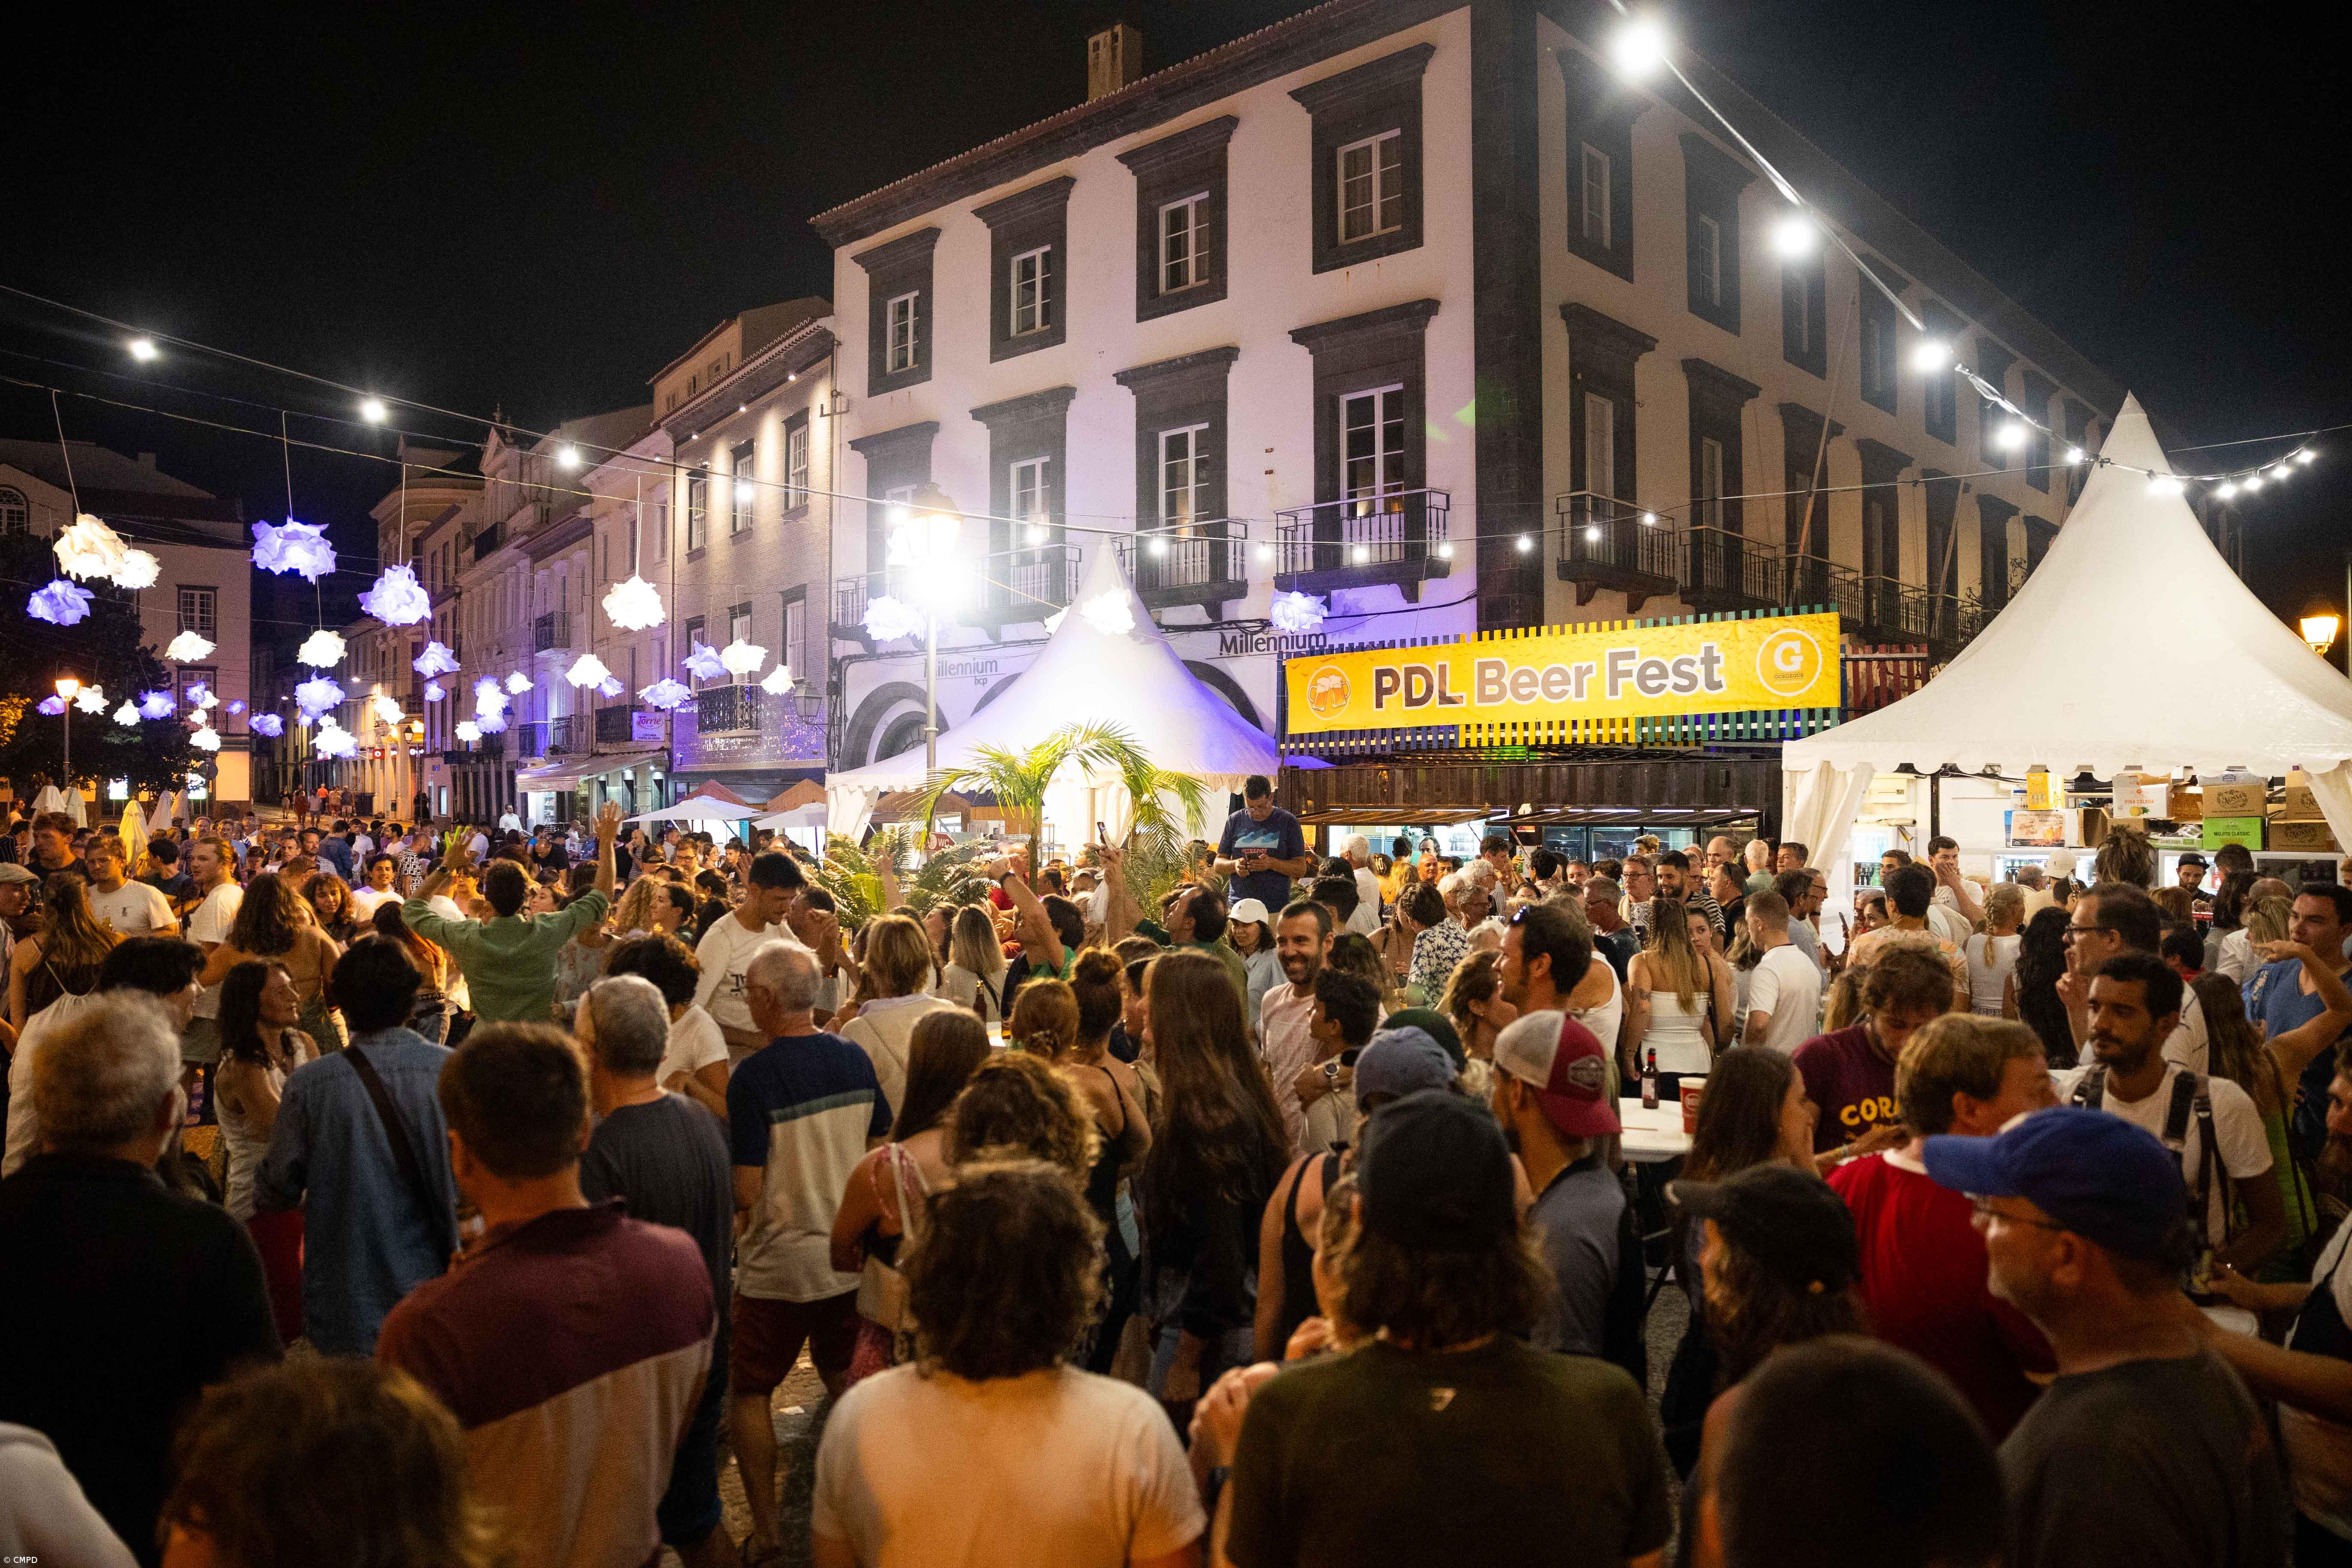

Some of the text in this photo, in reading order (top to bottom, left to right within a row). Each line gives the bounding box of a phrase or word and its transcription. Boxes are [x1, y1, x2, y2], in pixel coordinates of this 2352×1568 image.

[1219, 631, 1327, 656] Millennium
[1774, 640, 1804, 672] G
[974, 676, 987, 686] bcp
[1374, 645, 1724, 710] PDL Beer Fest
[938, 838, 949, 847] WC
